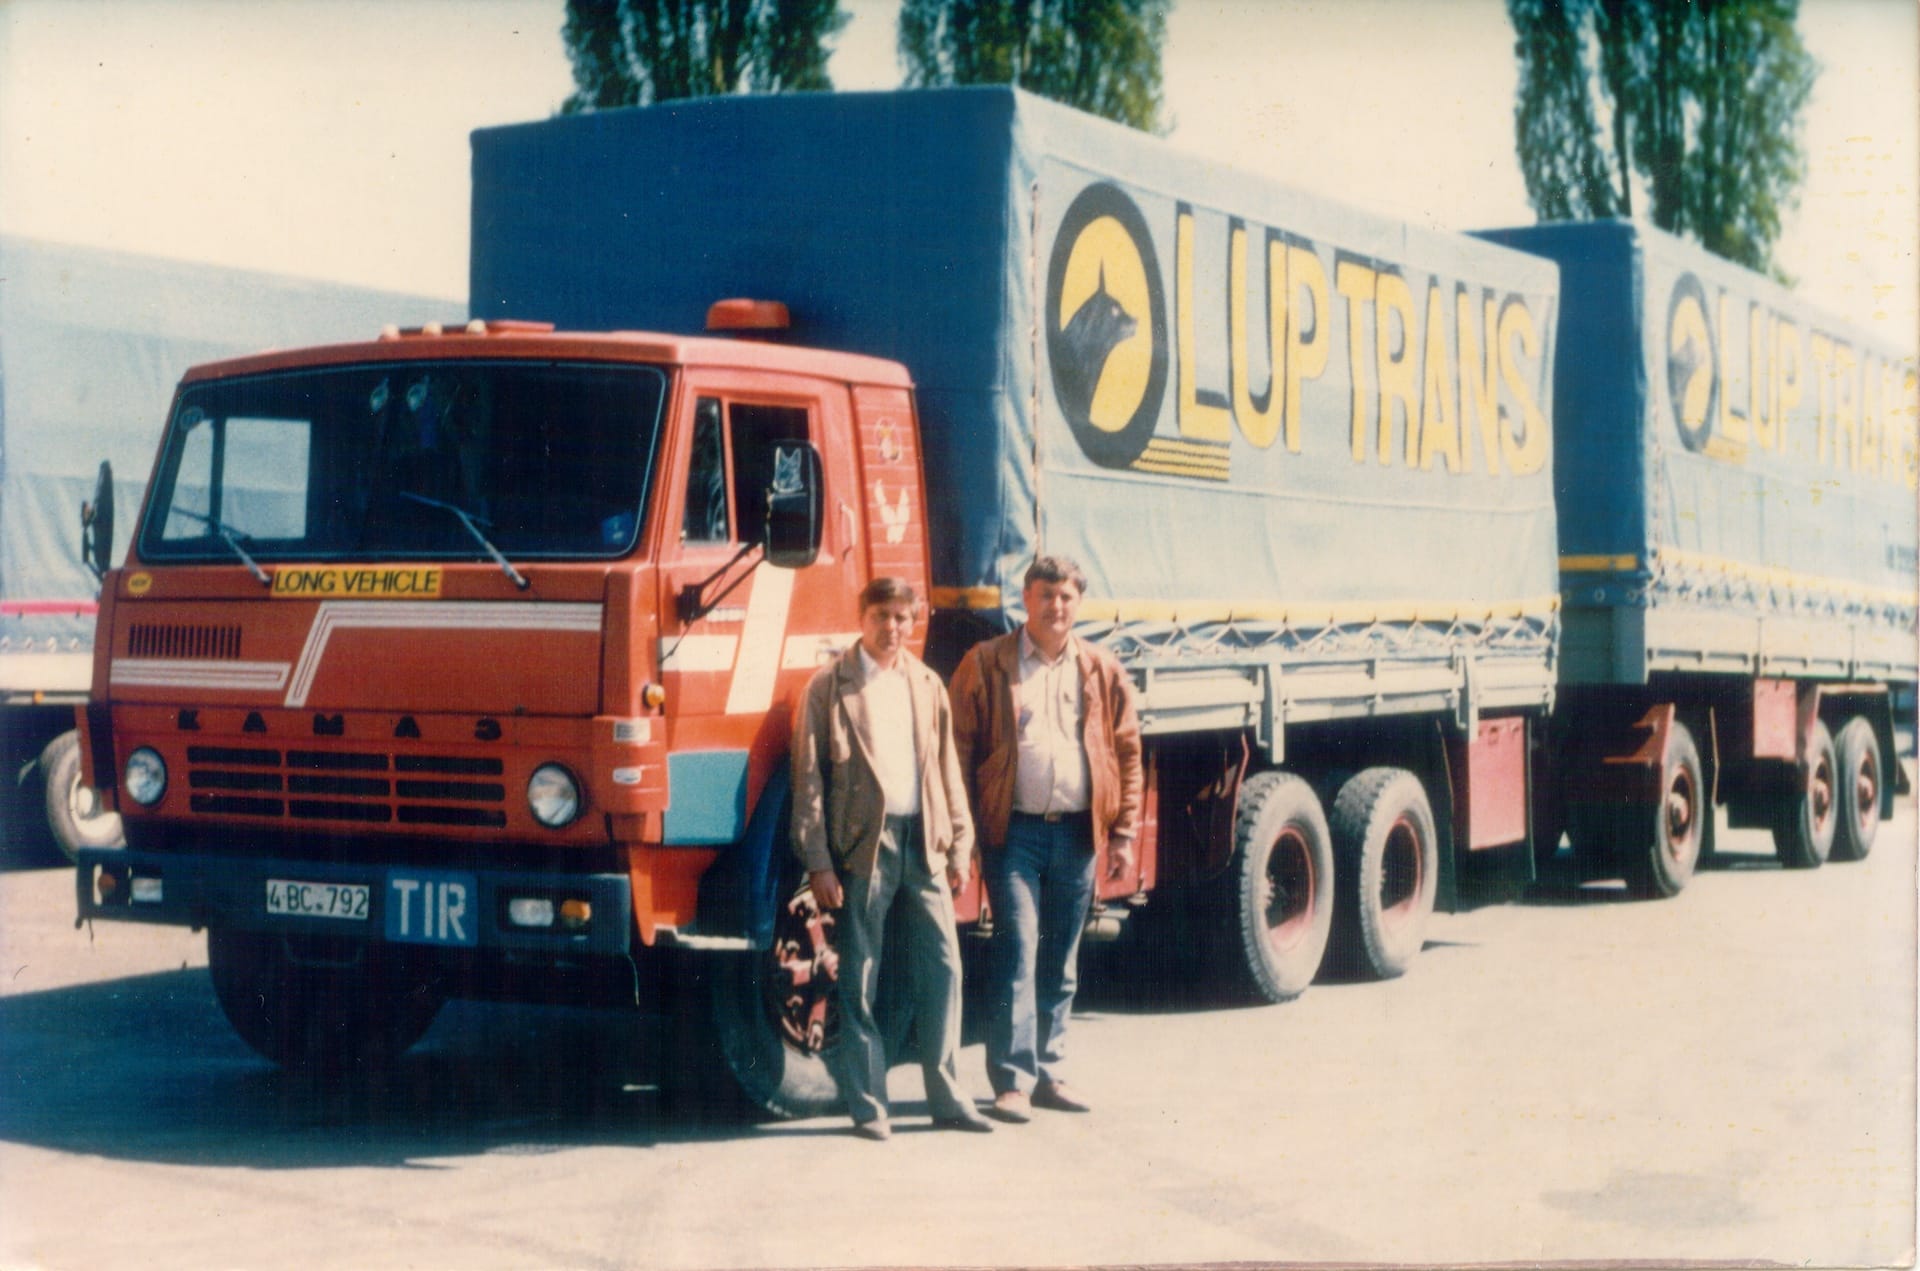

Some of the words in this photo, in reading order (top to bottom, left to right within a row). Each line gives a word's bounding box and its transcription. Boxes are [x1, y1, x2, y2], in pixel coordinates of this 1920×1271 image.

[1176, 200, 1331, 455] LUP
[1334, 246, 1548, 477] TRANS
[1718, 286, 1803, 456] LUP
[274, 569, 337, 593] LONG
[342, 569, 440, 594] VEHICLE
[392, 878, 466, 940] TIR
